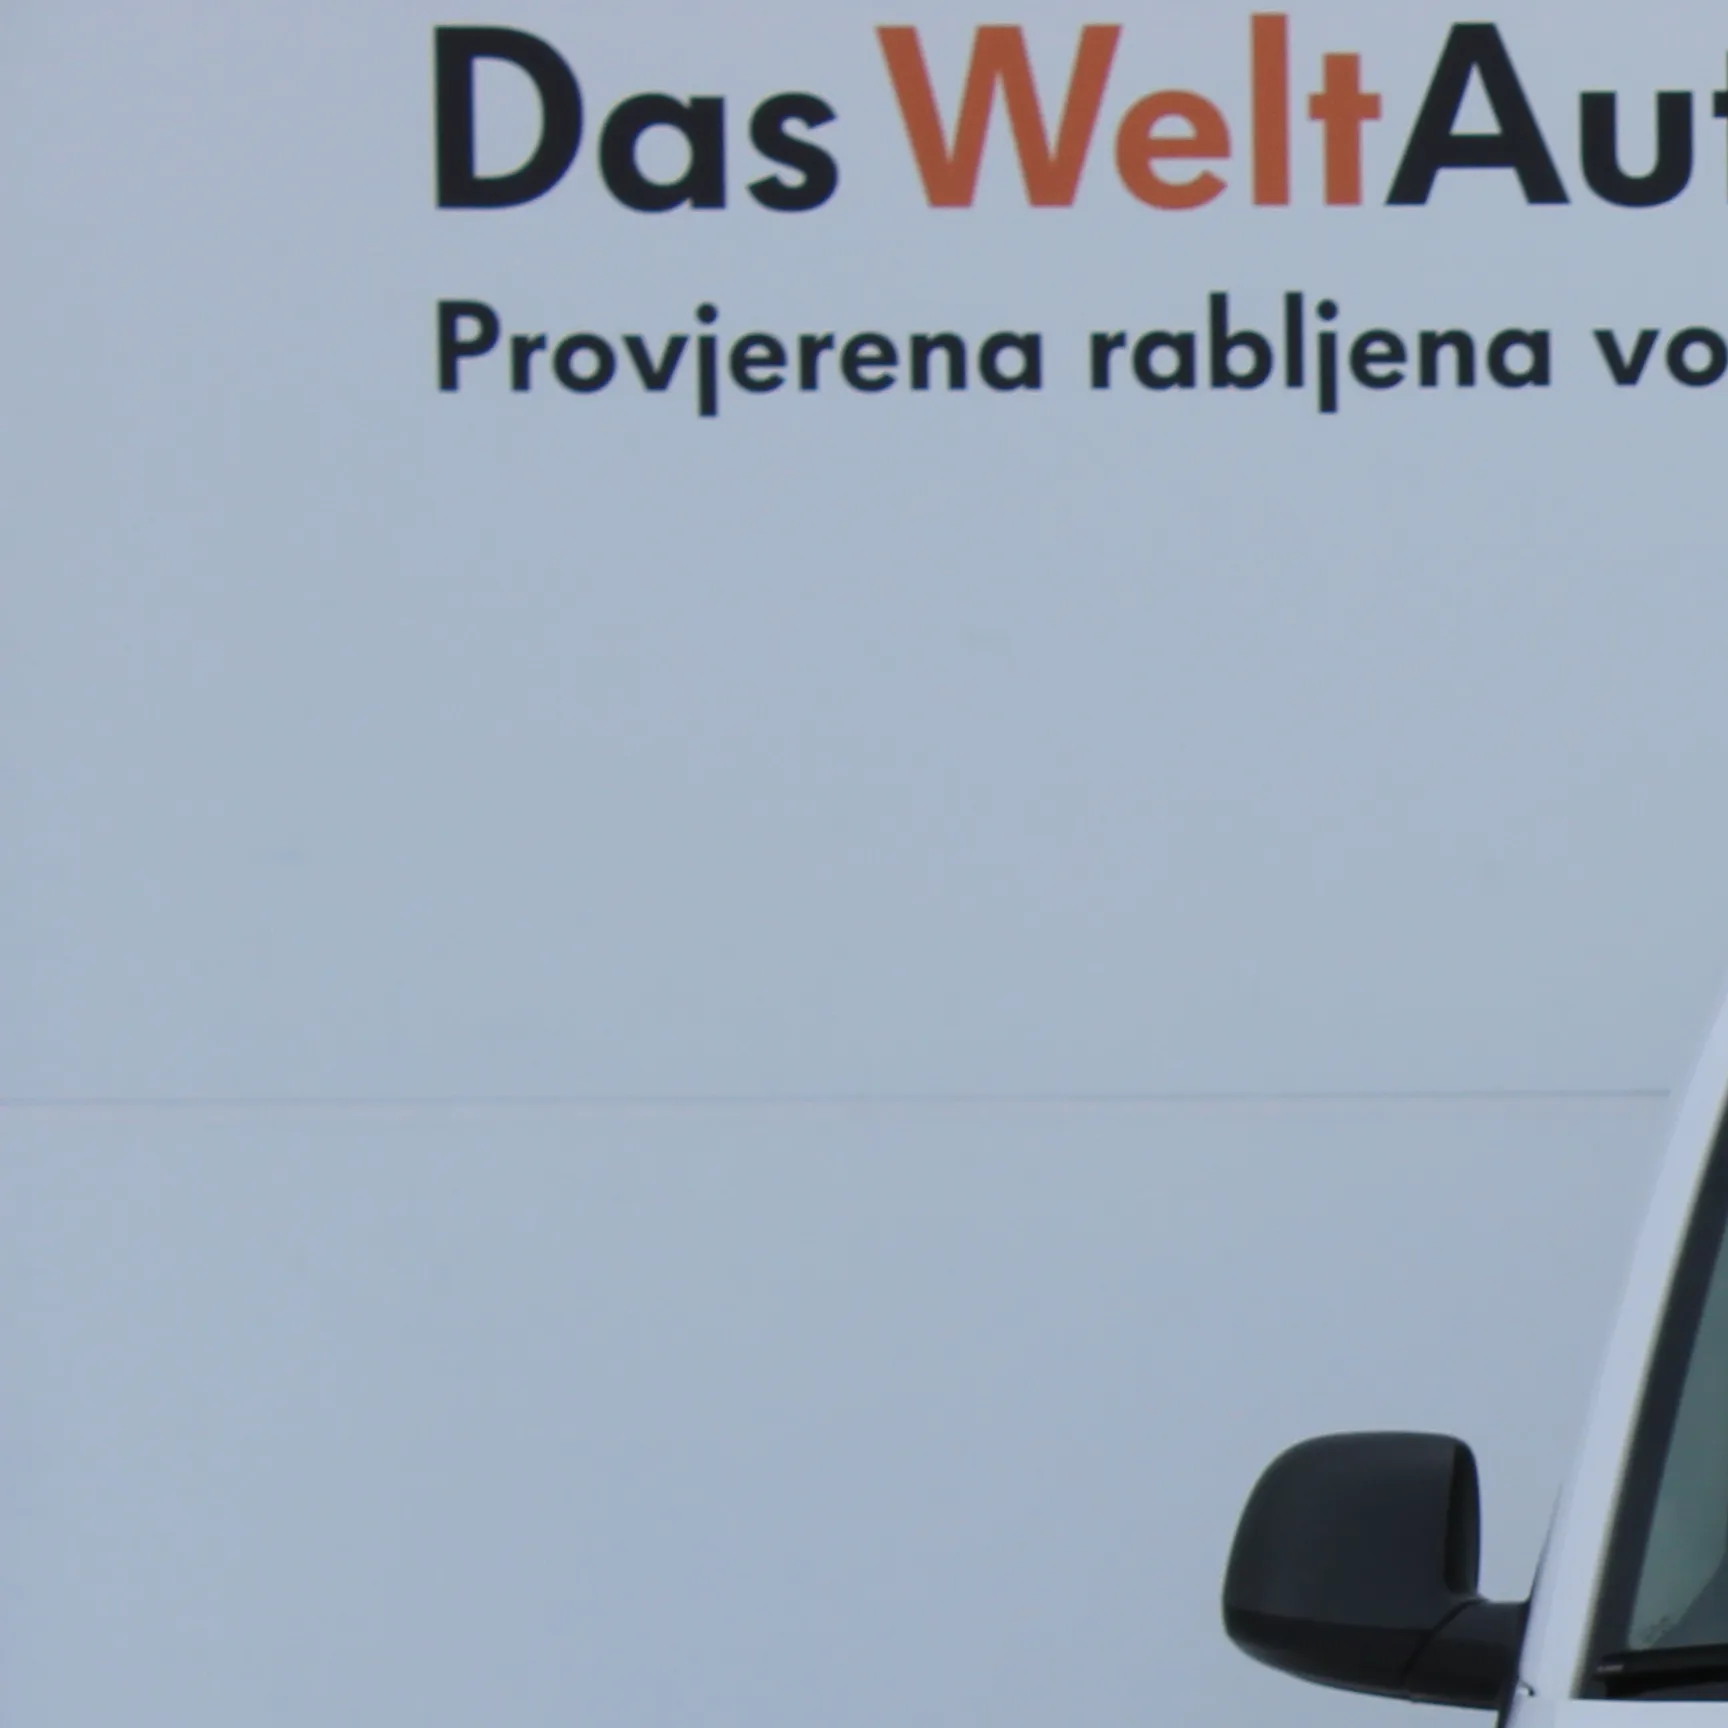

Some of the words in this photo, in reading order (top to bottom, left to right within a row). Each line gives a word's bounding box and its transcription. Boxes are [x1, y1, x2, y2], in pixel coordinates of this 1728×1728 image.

[432, 24, 839, 214] Das
[436, 299, 1044, 418] Provjerena
[1089, 290, 1552, 414] rabljena
